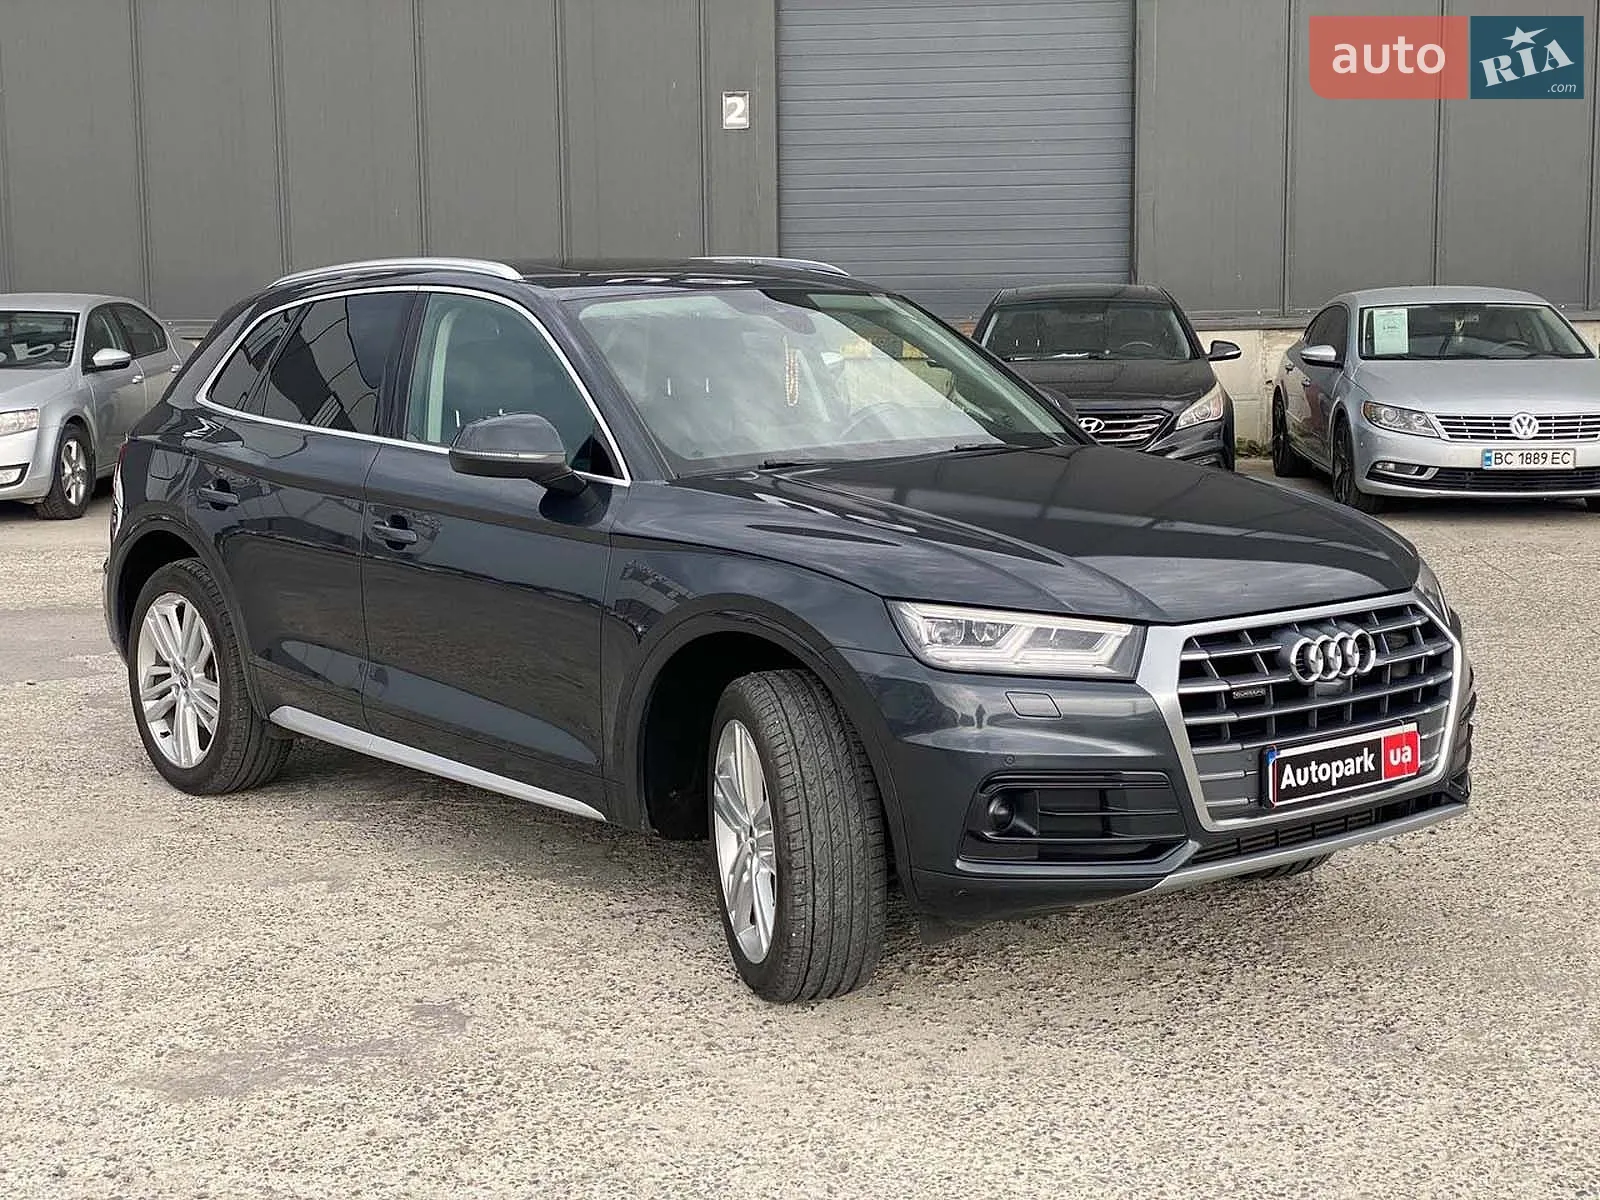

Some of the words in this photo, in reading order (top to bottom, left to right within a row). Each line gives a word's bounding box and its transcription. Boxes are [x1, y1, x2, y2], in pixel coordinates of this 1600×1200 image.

[725, 96, 747, 125] 2
[1494, 452, 1513, 465] BC
[1518, 452, 1548, 465] 1889
[1551, 452, 1571, 465] EC
[1280, 747, 1375, 790] Autopark
[1389, 745, 1412, 766] ua
